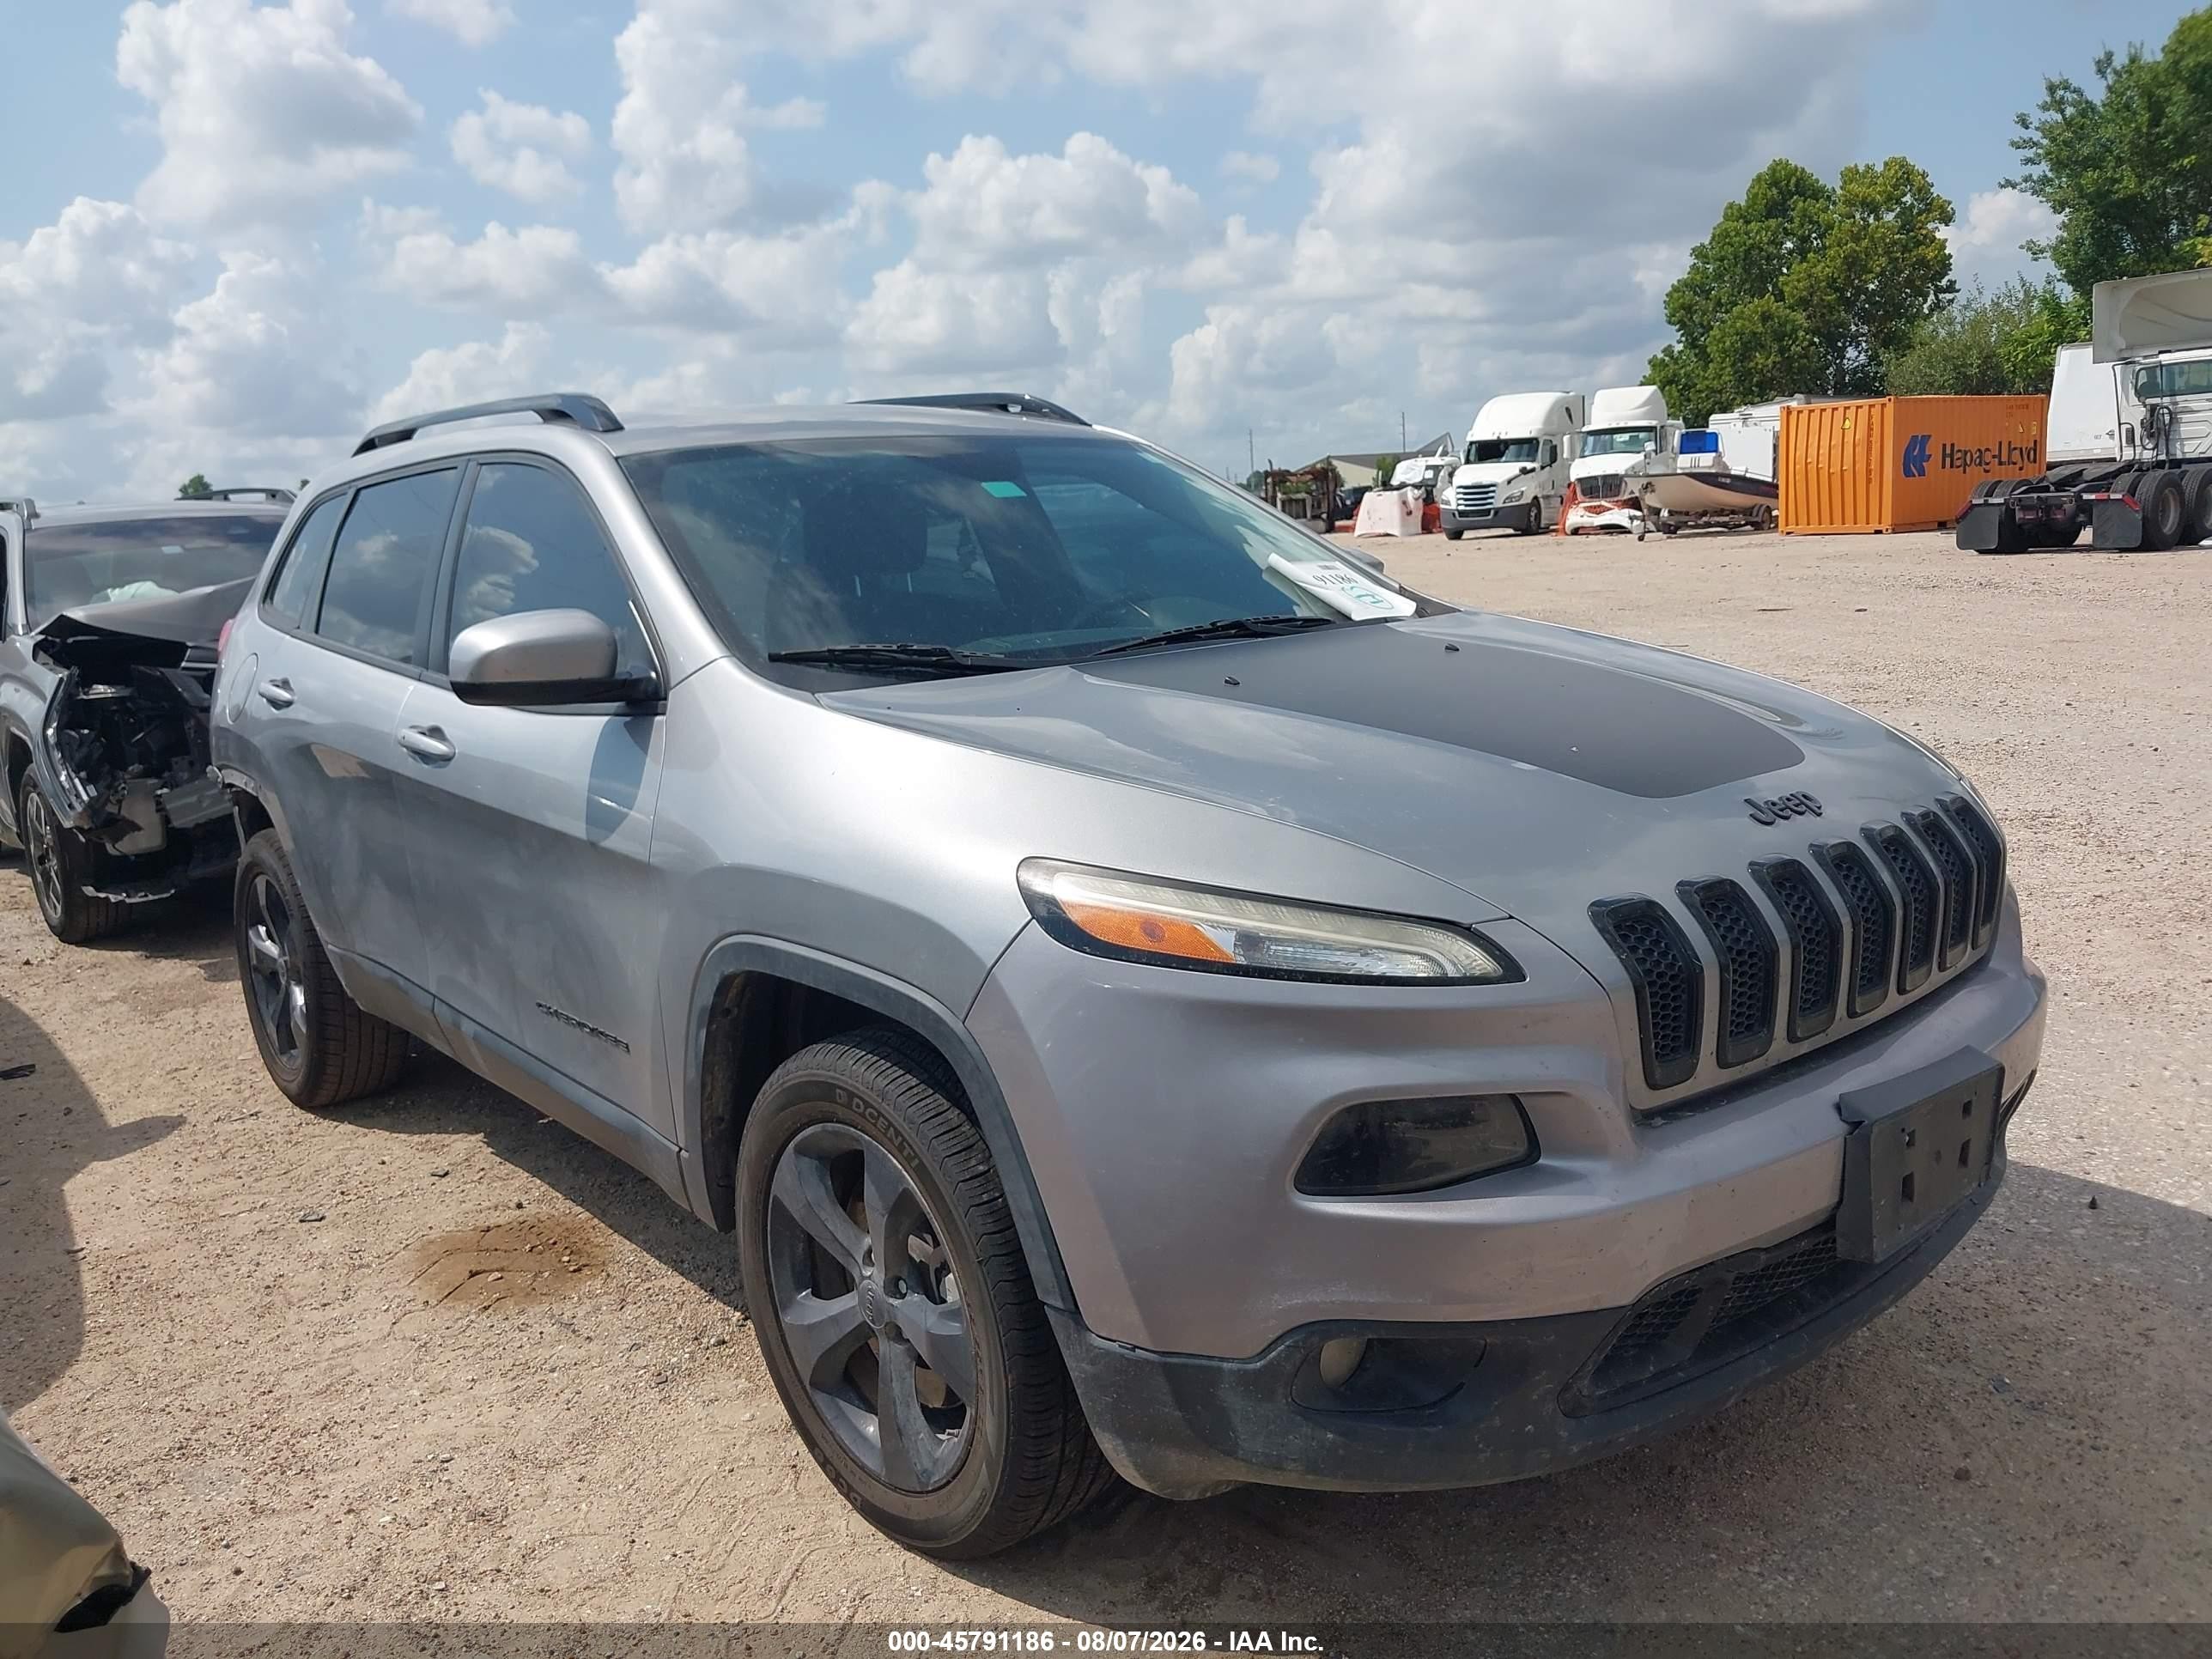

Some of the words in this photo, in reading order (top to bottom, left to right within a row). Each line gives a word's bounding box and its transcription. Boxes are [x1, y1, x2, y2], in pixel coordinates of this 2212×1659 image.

[1941, 439, 2038, 474] Hapag-Lloyd
[1743, 791, 1823, 826] Jeep
[852, 1097, 920, 1168] DCENTI
